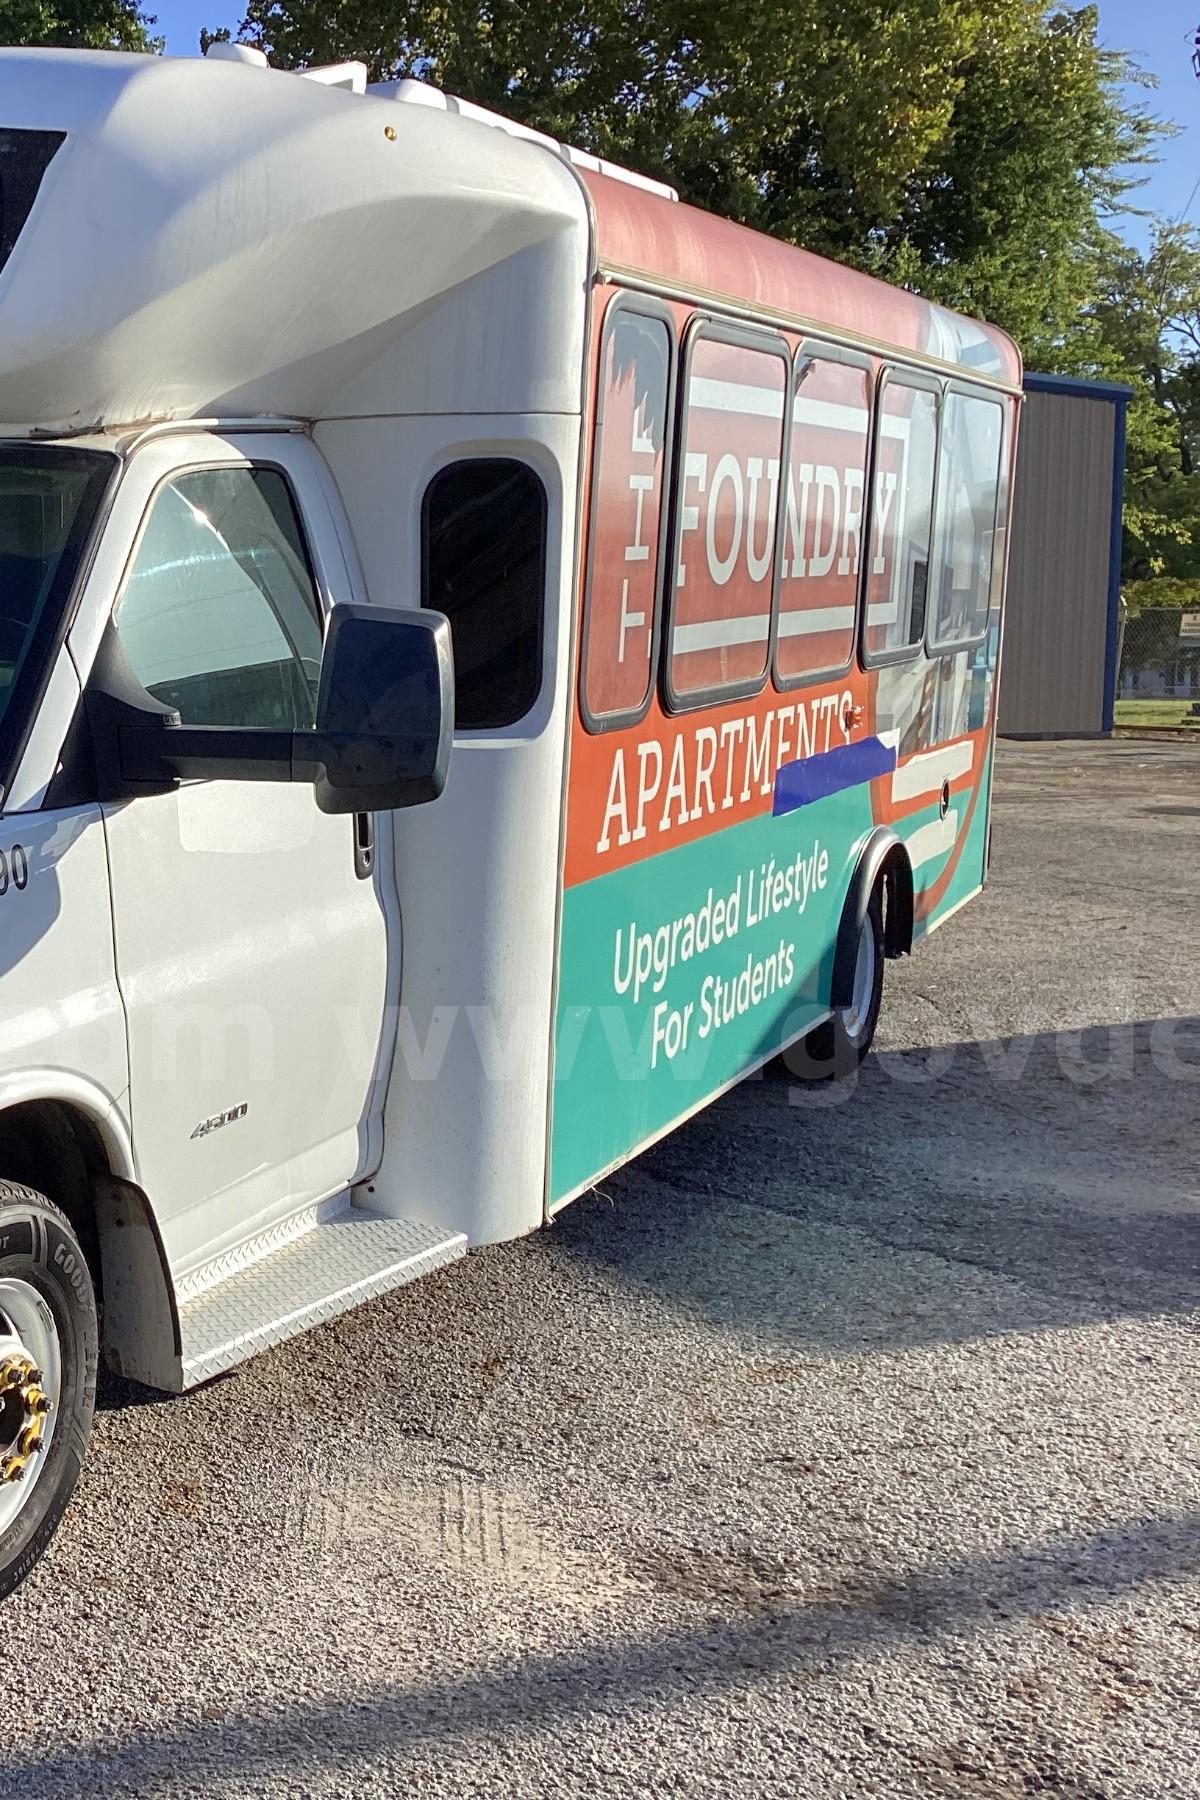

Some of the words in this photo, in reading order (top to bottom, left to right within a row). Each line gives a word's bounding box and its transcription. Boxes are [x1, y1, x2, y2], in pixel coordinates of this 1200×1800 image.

[677, 453, 897, 587] FOUNDRY
[613, 874, 742, 1004] Upgraded
[746, 839, 829, 927] Lifestyle
[651, 1000, 694, 1069] For
[698, 939, 795, 1038] Students
[189, 1102, 248, 1140] 4500
